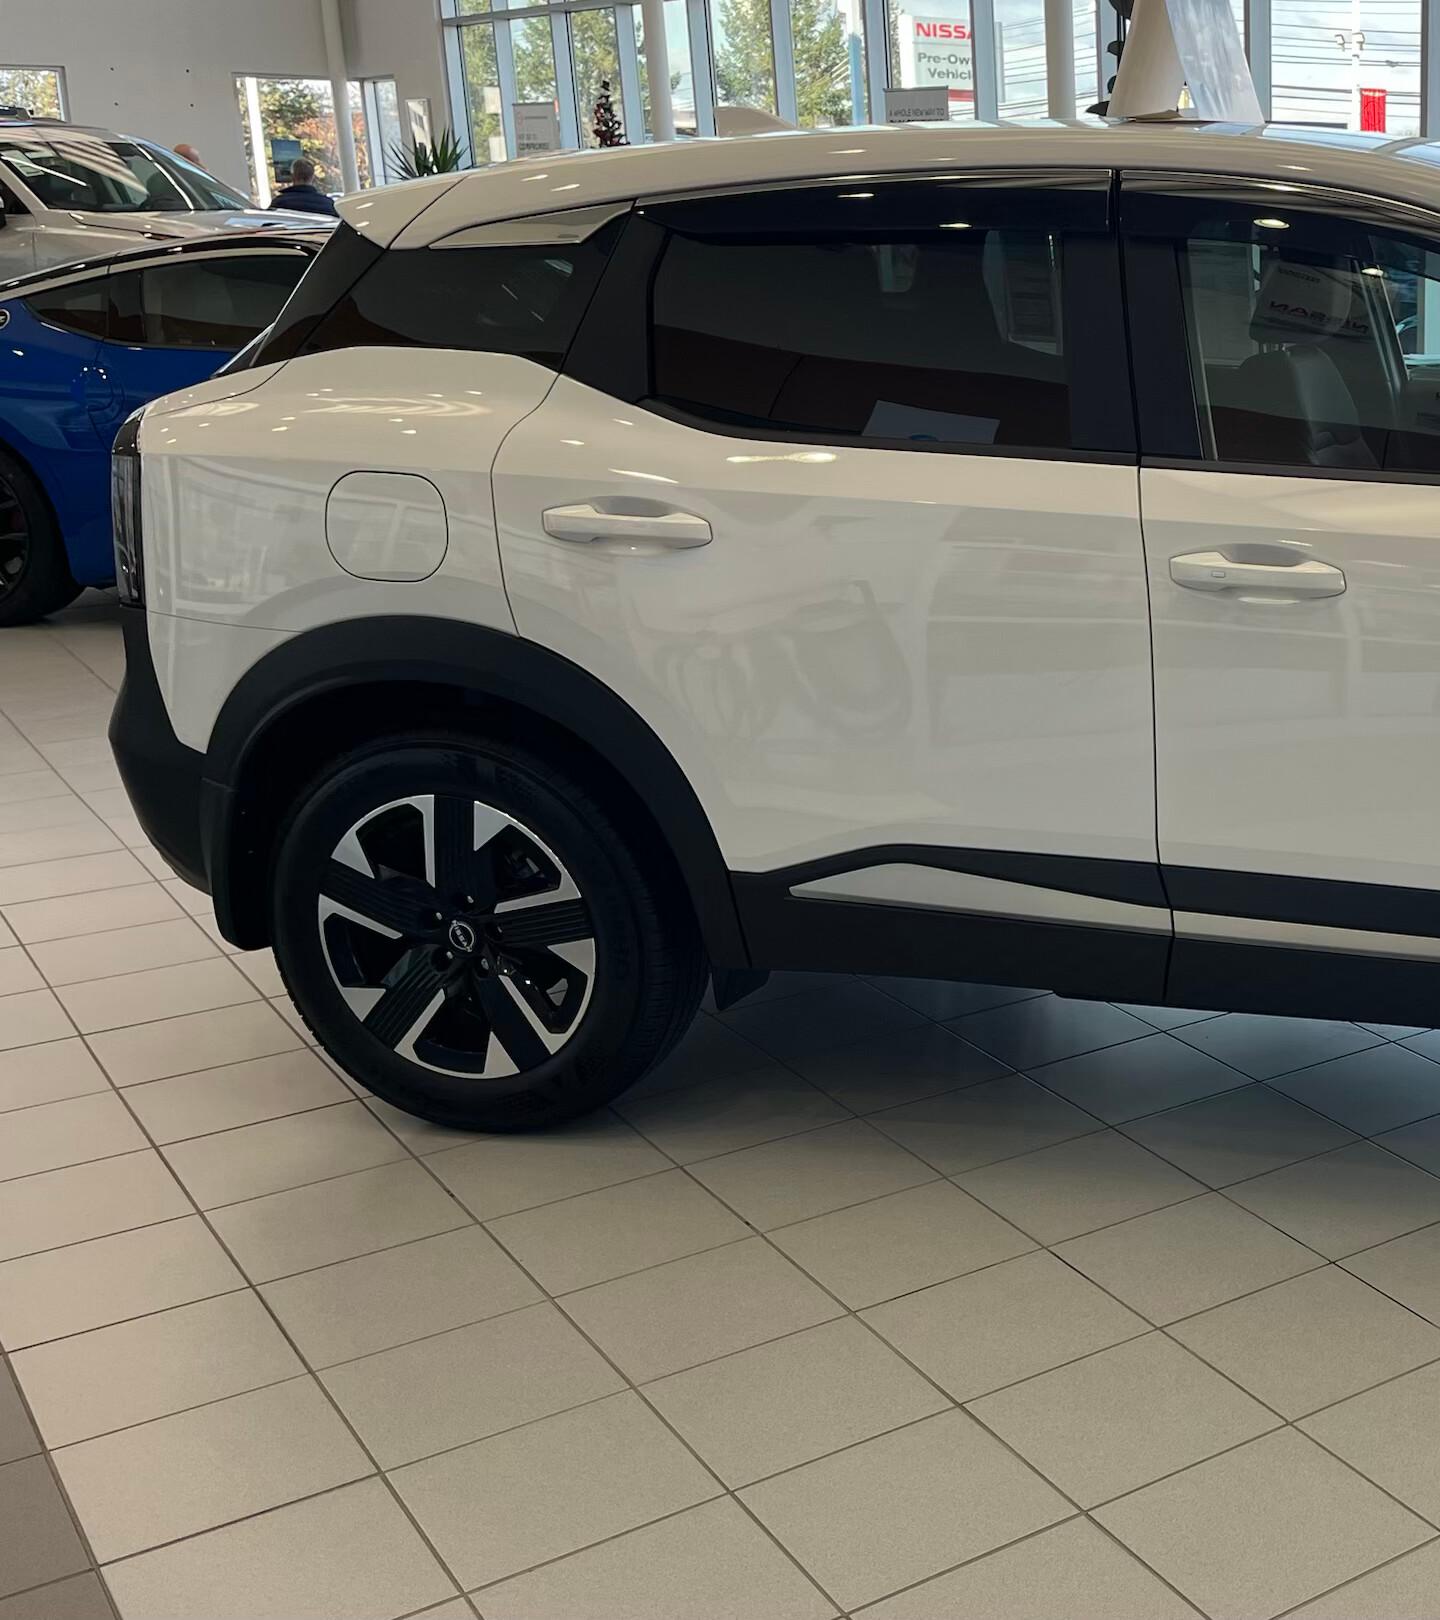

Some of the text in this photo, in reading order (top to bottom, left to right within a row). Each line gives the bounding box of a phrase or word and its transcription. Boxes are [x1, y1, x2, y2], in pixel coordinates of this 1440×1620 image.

[915, 22, 972, 40] NISS
[917, 52, 970, 65] Pre-Ow
[927, 68, 972, 80] Vehicl
